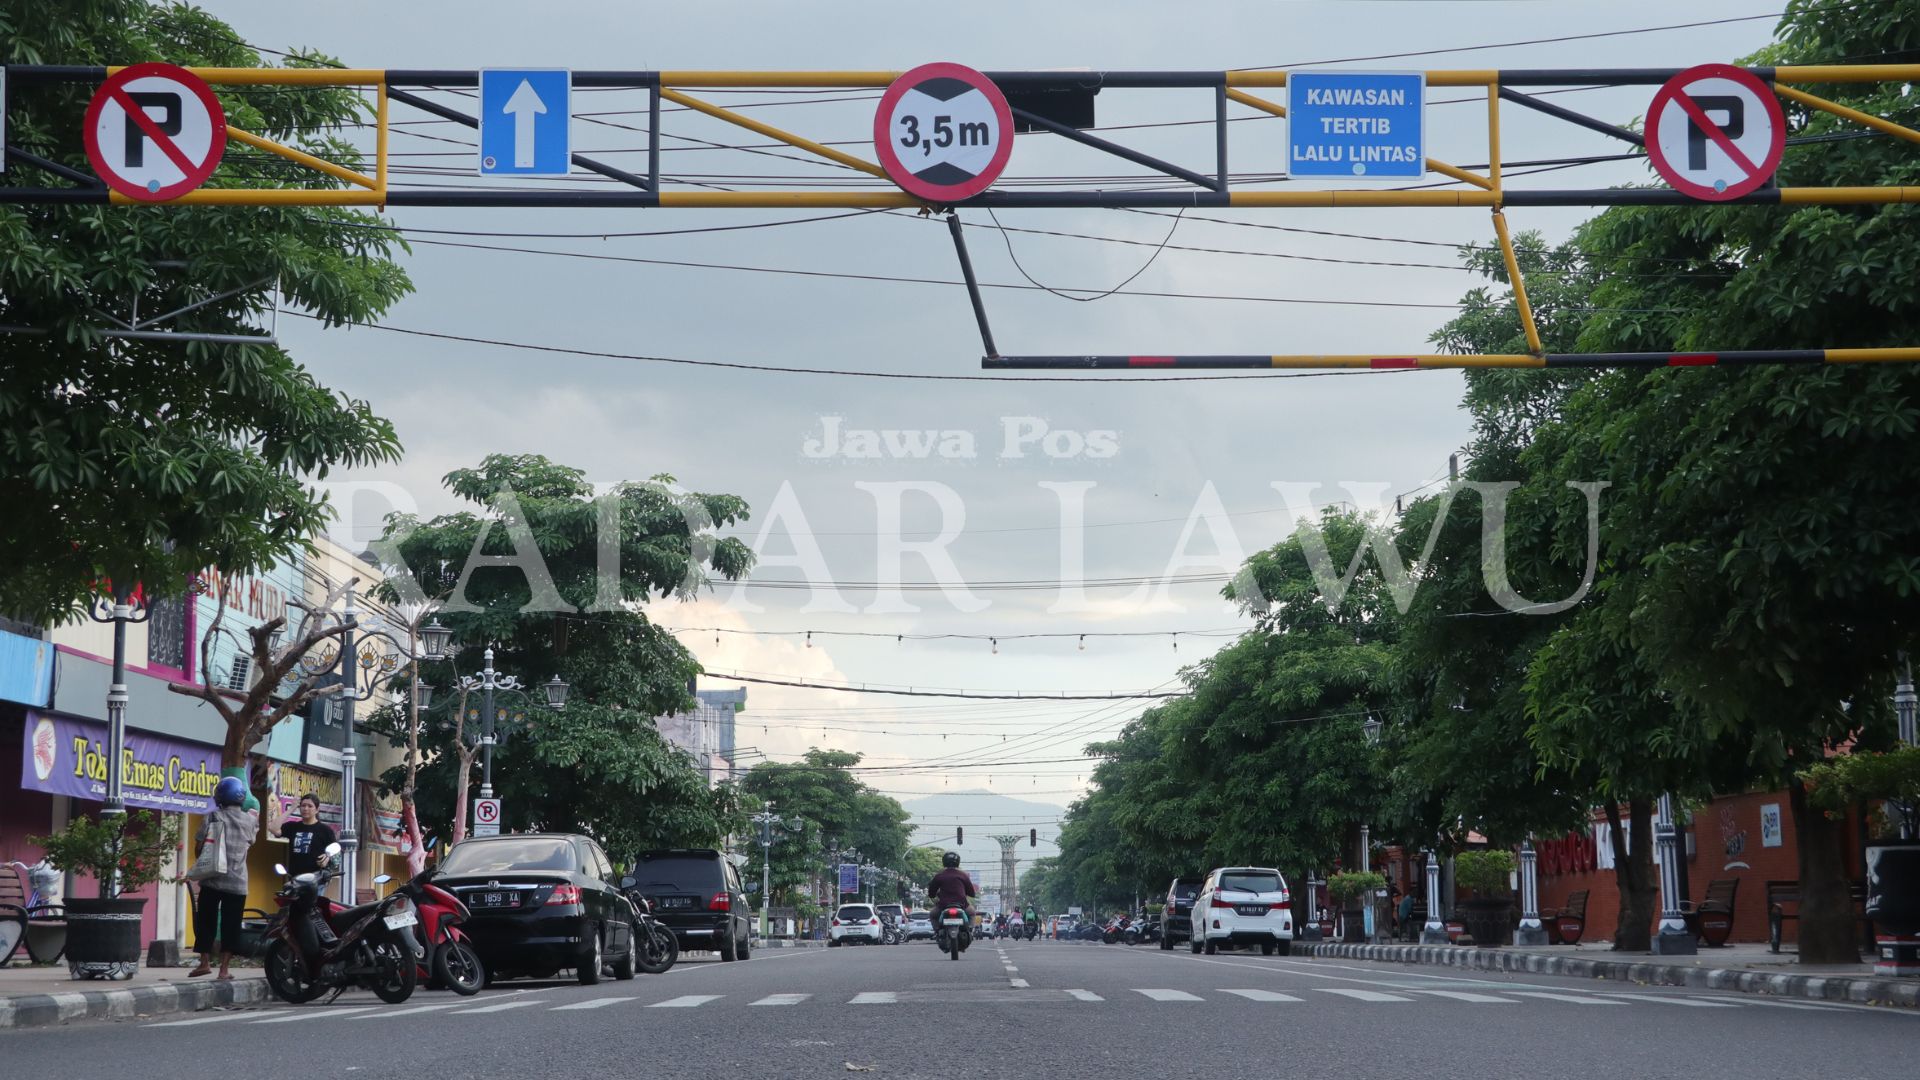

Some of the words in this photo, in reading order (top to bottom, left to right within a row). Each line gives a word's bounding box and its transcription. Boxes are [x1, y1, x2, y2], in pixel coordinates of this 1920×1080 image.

[1308, 88, 1404, 105] KAWASAN
[1320, 117, 1391, 134] TERTIB
[1293, 145, 1342, 161] LALU
[1349, 145, 1417, 162] LINTAS
[73, 736, 107, 782] Tok
[122, 748, 166, 791] Emas
[484, 894, 501, 903] 1859
[509, 894, 519, 902] XA
